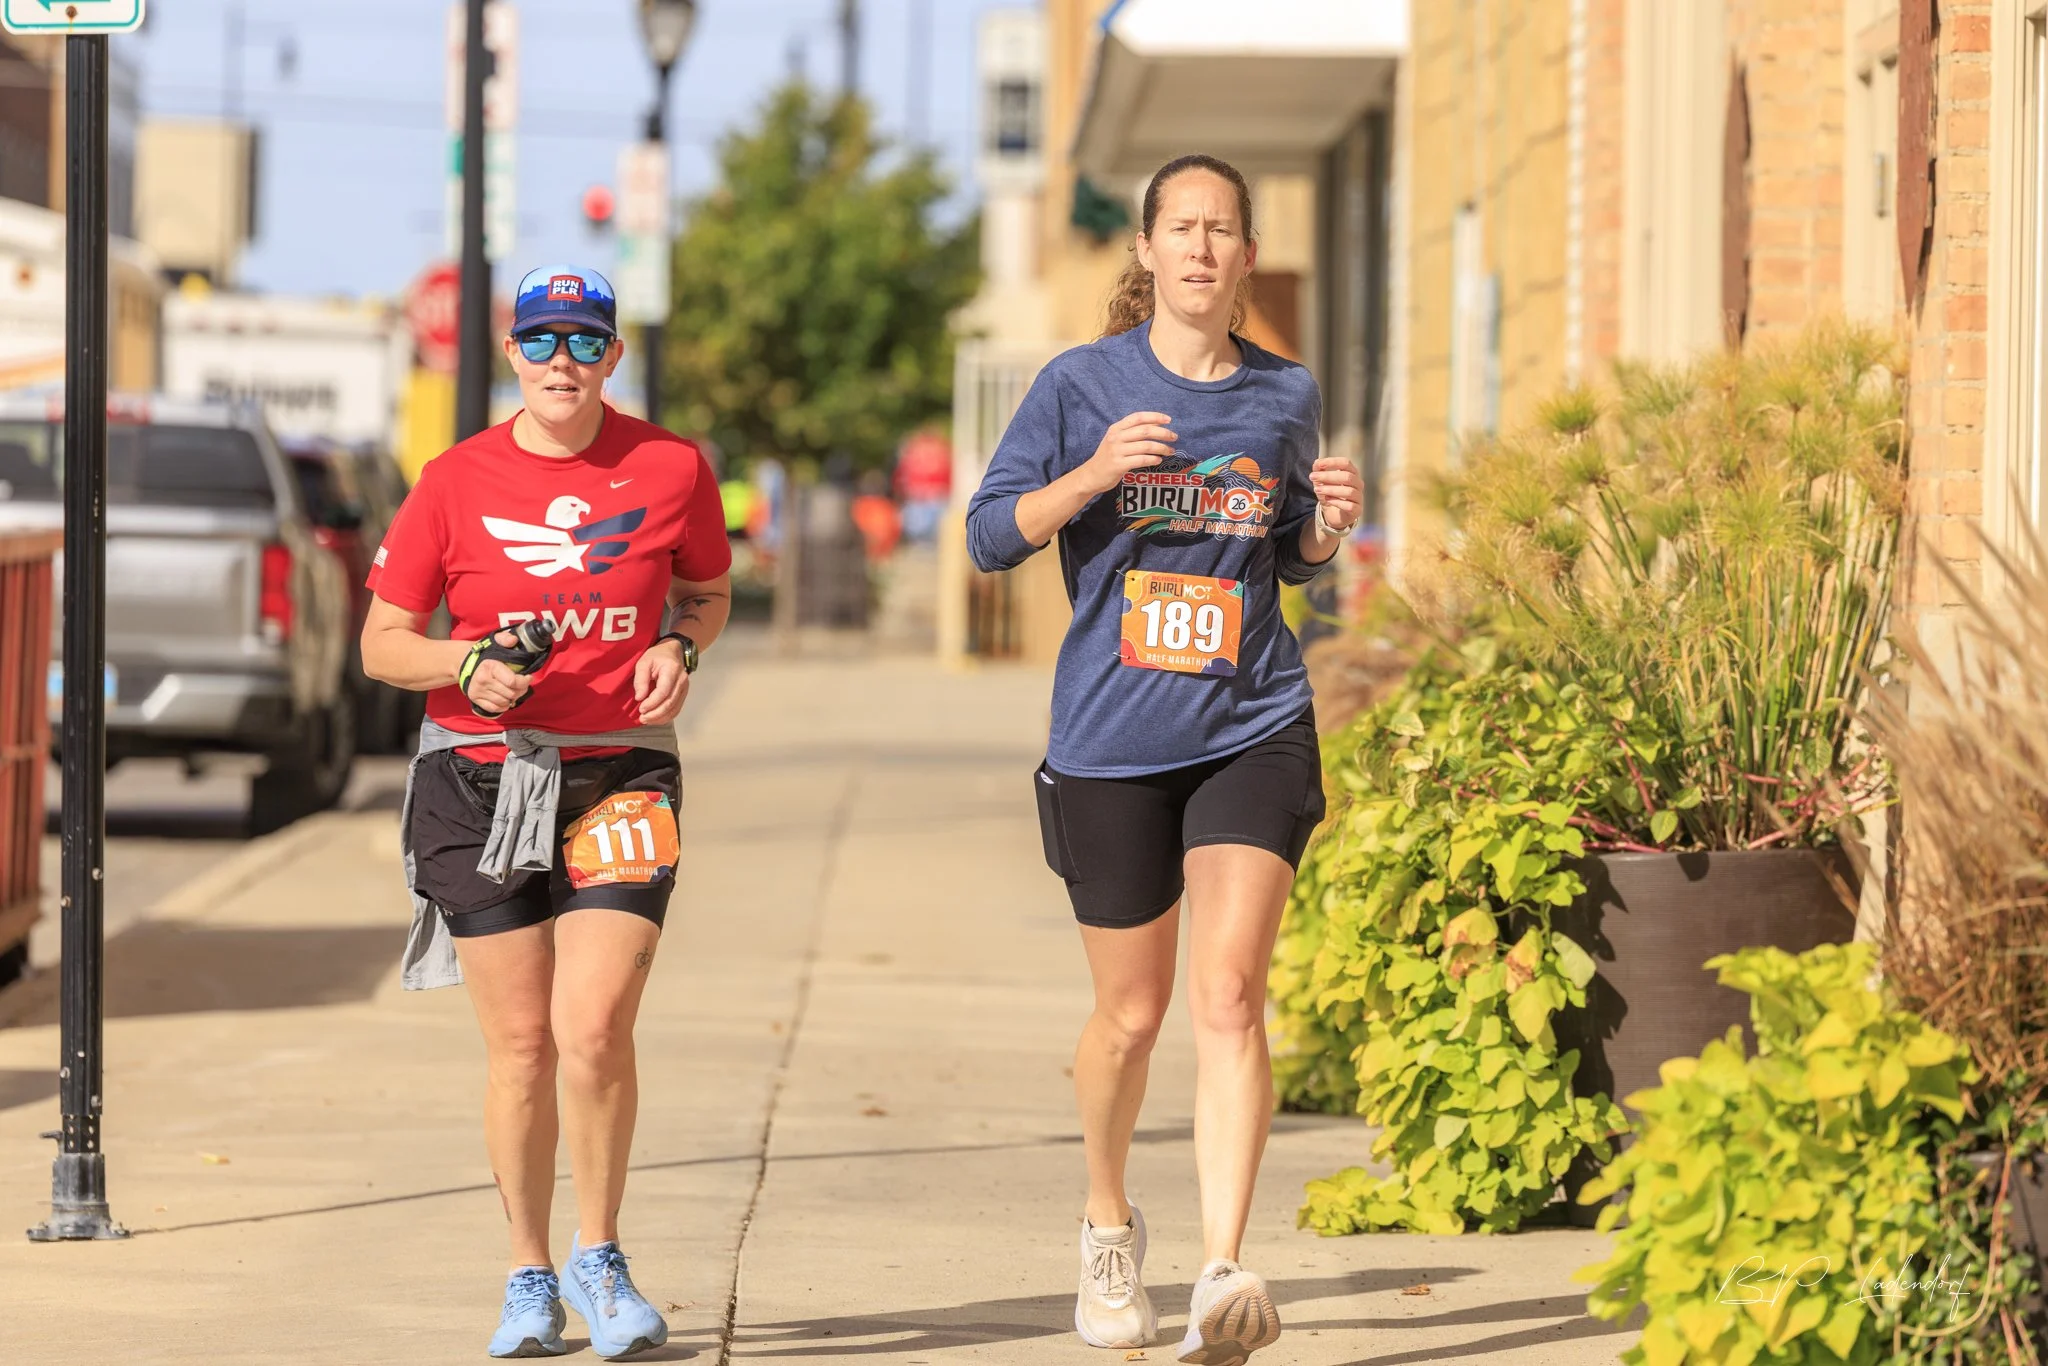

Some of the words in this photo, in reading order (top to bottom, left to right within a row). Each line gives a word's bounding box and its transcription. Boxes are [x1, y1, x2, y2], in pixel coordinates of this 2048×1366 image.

[553, 279, 579, 288] RUN
[552, 287, 578, 296] PLR
[1122, 473, 1204, 486] SCHEELS
[1232, 497, 1246, 510] 26
[1168, 519, 1204, 532] HALF
[542, 591, 603, 605] TEAM
[1140, 599, 1225, 653] 189
[1146, 653, 1165, 662] HALF
[1168, 654, 1213, 668] MARATHON
[587, 817, 656, 864] 111
[596, 867, 618, 878] HALF
[618, 866, 659, 876] MARATHON
